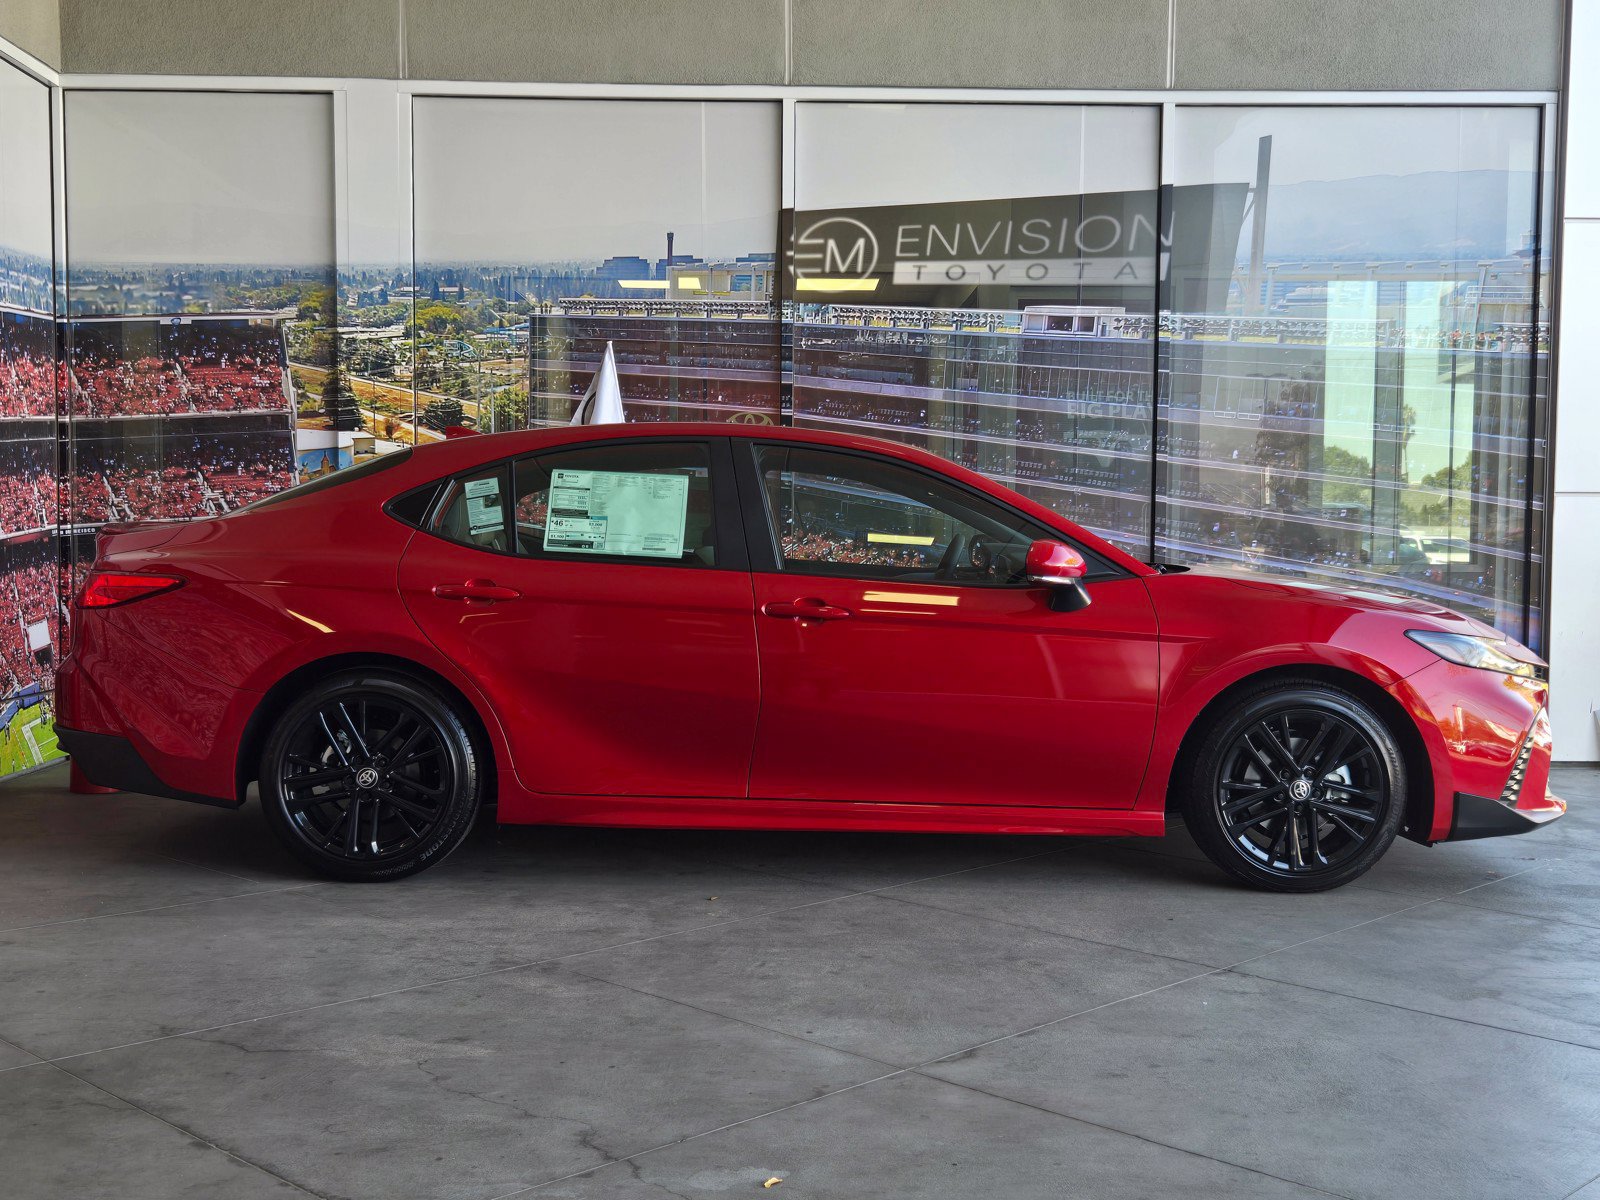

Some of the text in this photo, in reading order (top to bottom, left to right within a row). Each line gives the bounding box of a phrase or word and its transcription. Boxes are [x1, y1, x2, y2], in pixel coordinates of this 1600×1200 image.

[895, 211, 1176, 257] ENVISION
[912, 261, 1138, 281] TOYOTA
[1107, 391, 1134, 402] FOR
[1067, 403, 1103, 419] BIG
